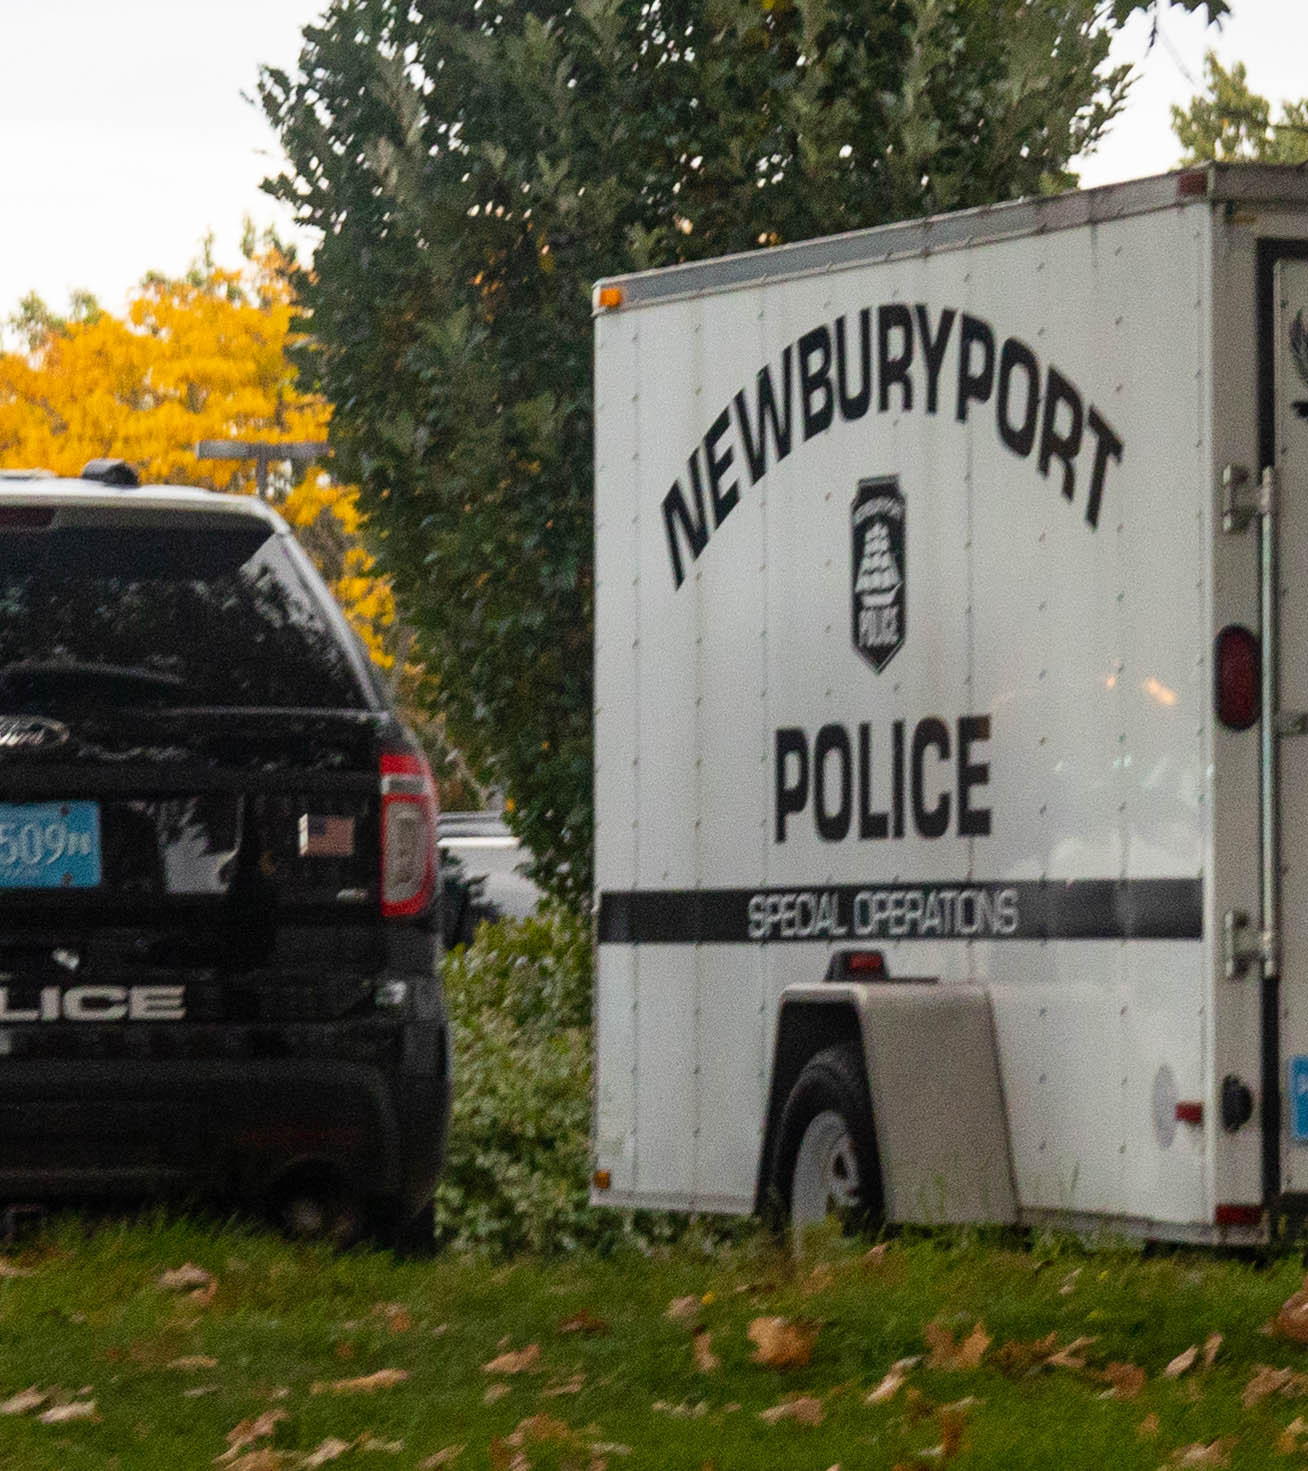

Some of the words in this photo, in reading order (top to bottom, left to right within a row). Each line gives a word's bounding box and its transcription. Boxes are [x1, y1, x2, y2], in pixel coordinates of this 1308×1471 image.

[661, 302, 1124, 592] NEWBURYPORT
[775, 715, 992, 843] POLICE
[749, 891, 848, 937] SPECIAL
[853, 887, 1019, 935] OPERATIONS
